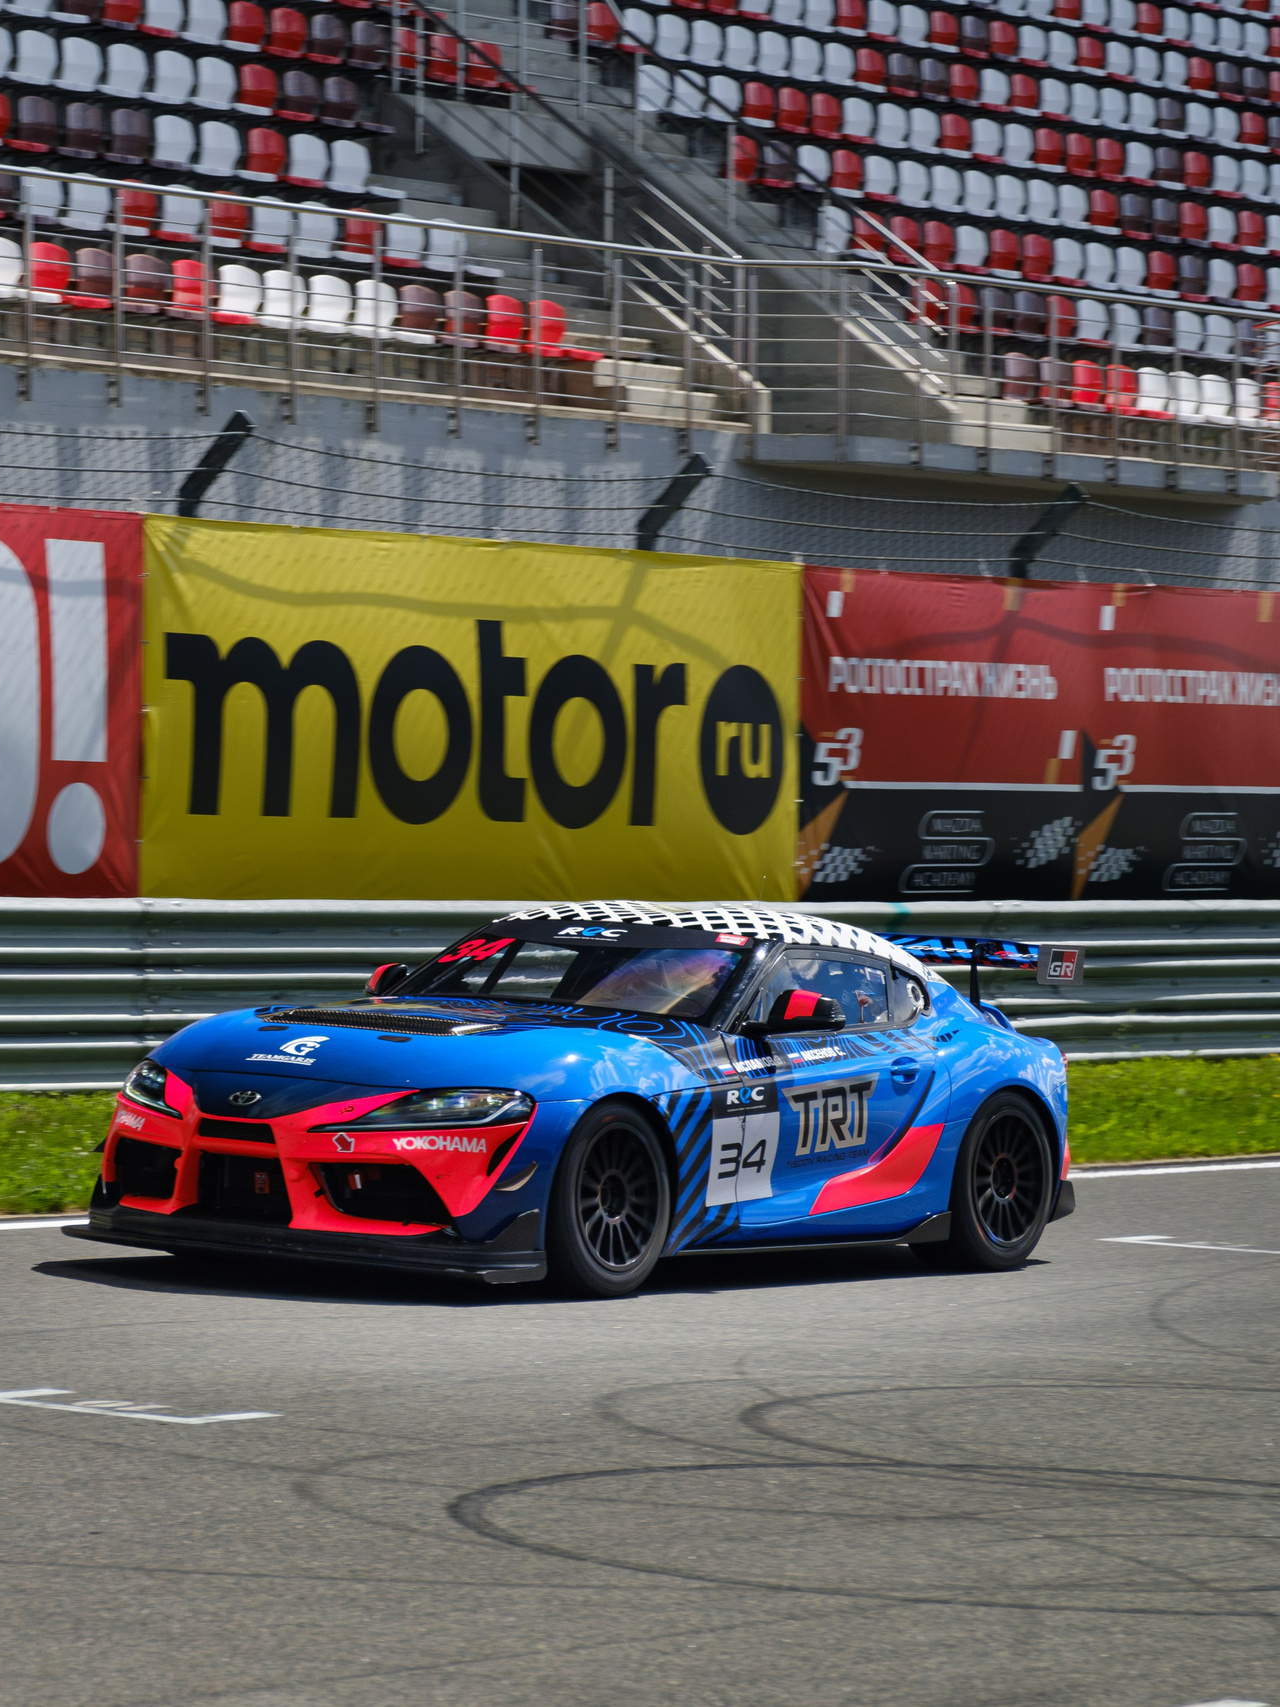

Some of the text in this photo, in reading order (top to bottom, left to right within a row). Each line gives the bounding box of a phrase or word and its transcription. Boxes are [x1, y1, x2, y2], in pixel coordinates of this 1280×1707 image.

[163, 619, 772, 830] motor ru
[437, 938, 516, 963] 34
[1048, 961, 1074, 977] GR
[782, 1073, 879, 1156] TRT
[392, 1135, 487, 1153] YOKOHAMA
[848, 1148, 870, 1160] TEAM
[717, 1139, 767, 1180] 34
